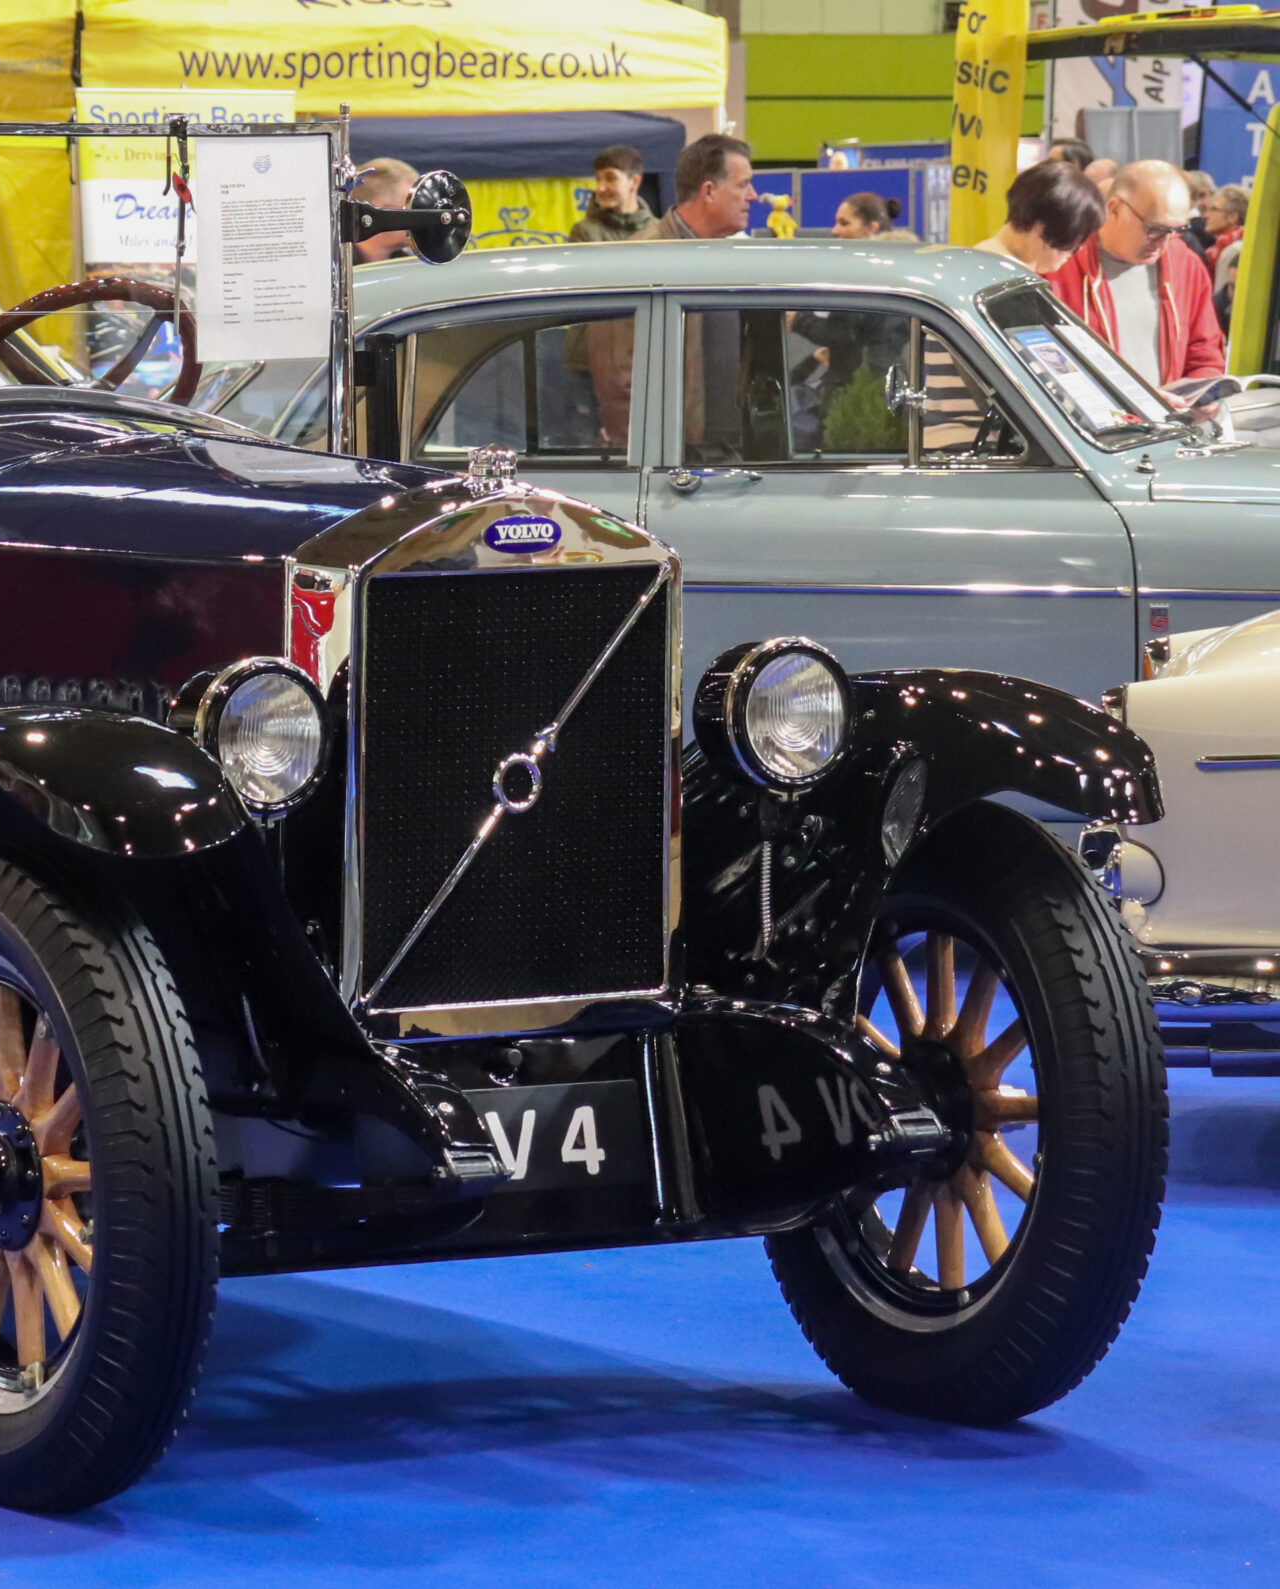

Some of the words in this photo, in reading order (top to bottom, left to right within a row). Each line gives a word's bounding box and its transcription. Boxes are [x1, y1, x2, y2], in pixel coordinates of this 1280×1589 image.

[179, 40, 631, 88] www.sportingbears.co.uk
[495, 523, 554, 540] VOLVO
[485, 1110, 535, 1180] V
[561, 1105, 606, 1175] 4
